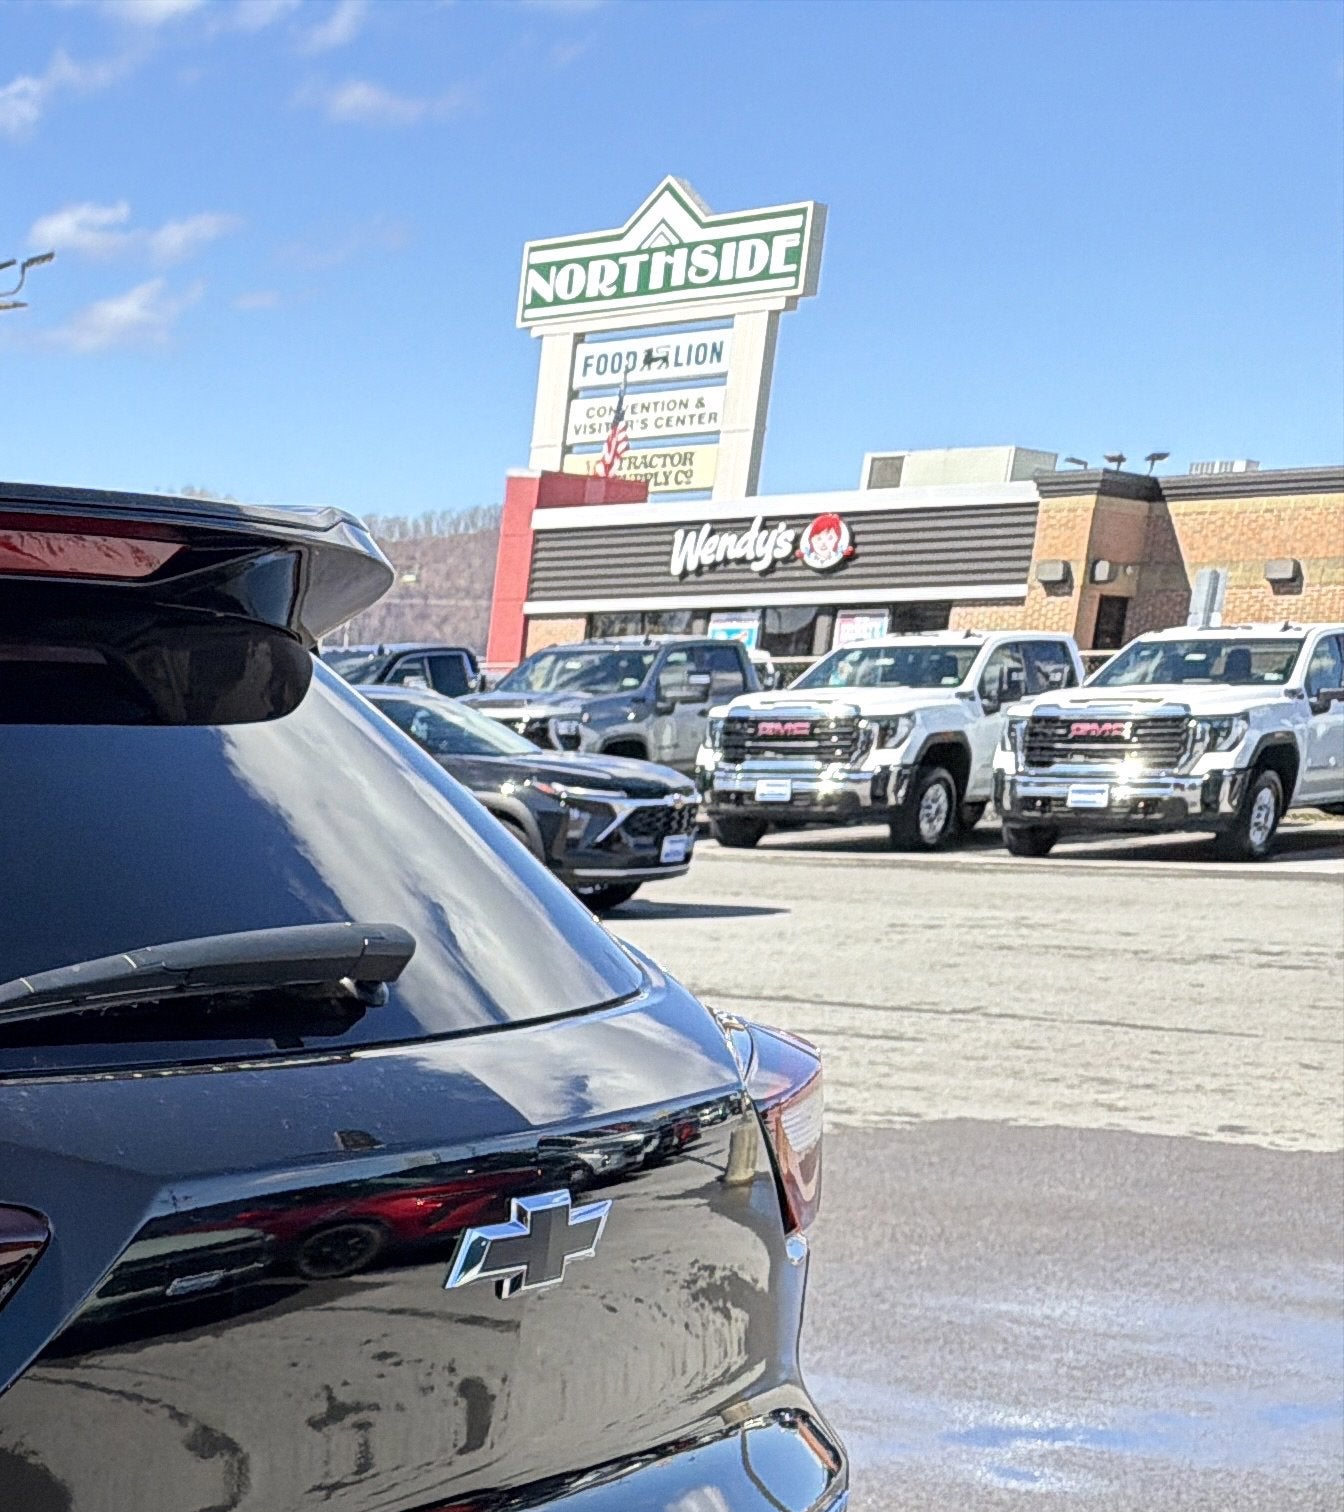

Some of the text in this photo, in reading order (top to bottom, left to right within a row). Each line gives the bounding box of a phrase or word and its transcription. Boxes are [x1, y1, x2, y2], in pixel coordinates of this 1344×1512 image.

[526, 233, 801, 305] NORTHSIDE
[582, 341, 724, 377] FOOD LION
[574, 411, 718, 435] VISITR'S CENTER
[617, 452, 695, 471] TRACTOR
[615, 470, 673, 487] PPLY
[670, 514, 795, 576] Wendy's
